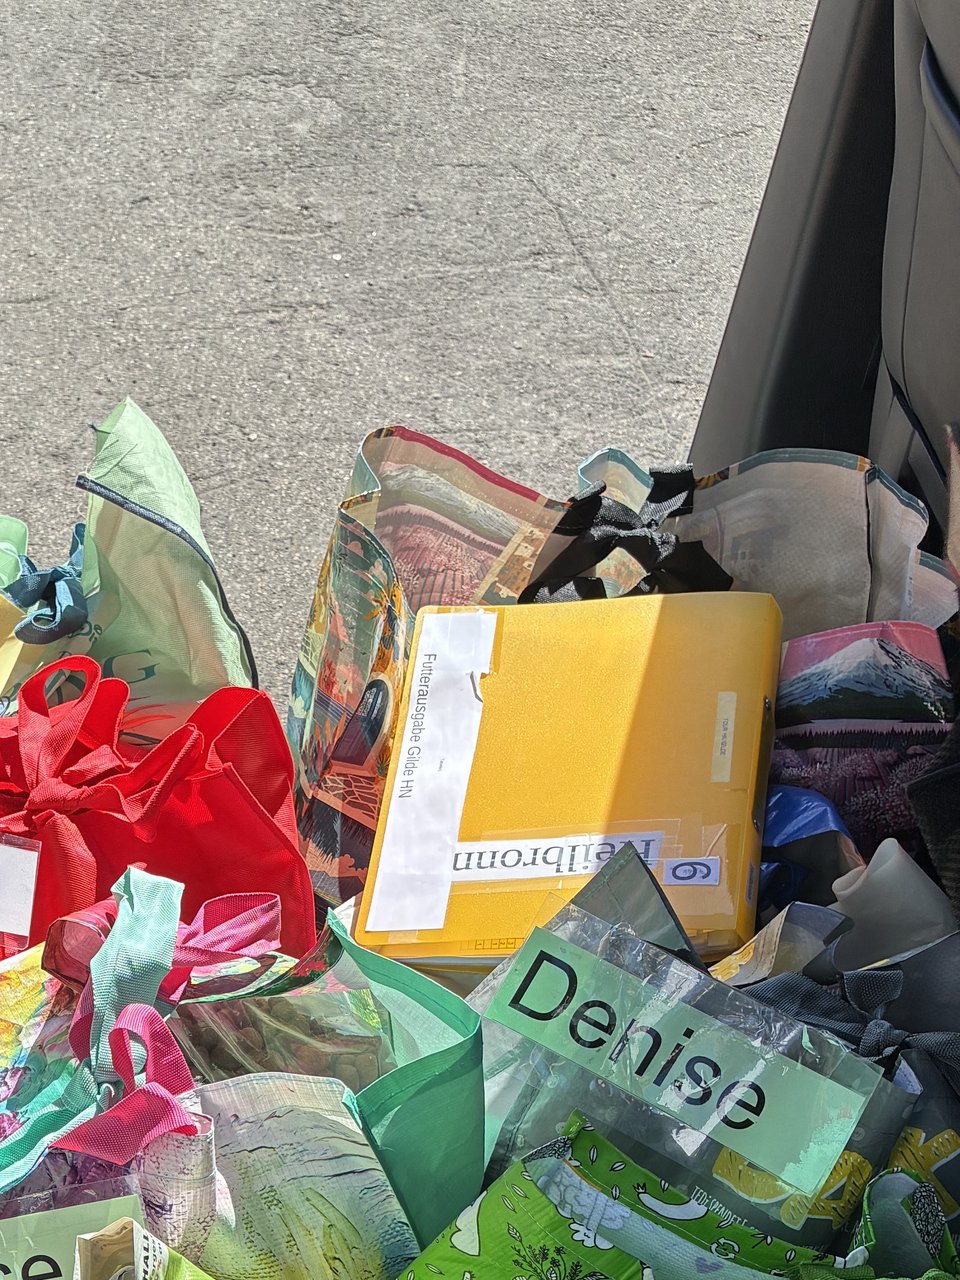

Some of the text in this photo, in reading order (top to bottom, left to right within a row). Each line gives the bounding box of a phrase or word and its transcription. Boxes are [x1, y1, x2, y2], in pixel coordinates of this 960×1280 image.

[398, 653, 437, 799] Futterausgabe Gilde HN
[507, 948, 767, 1130] Denise
